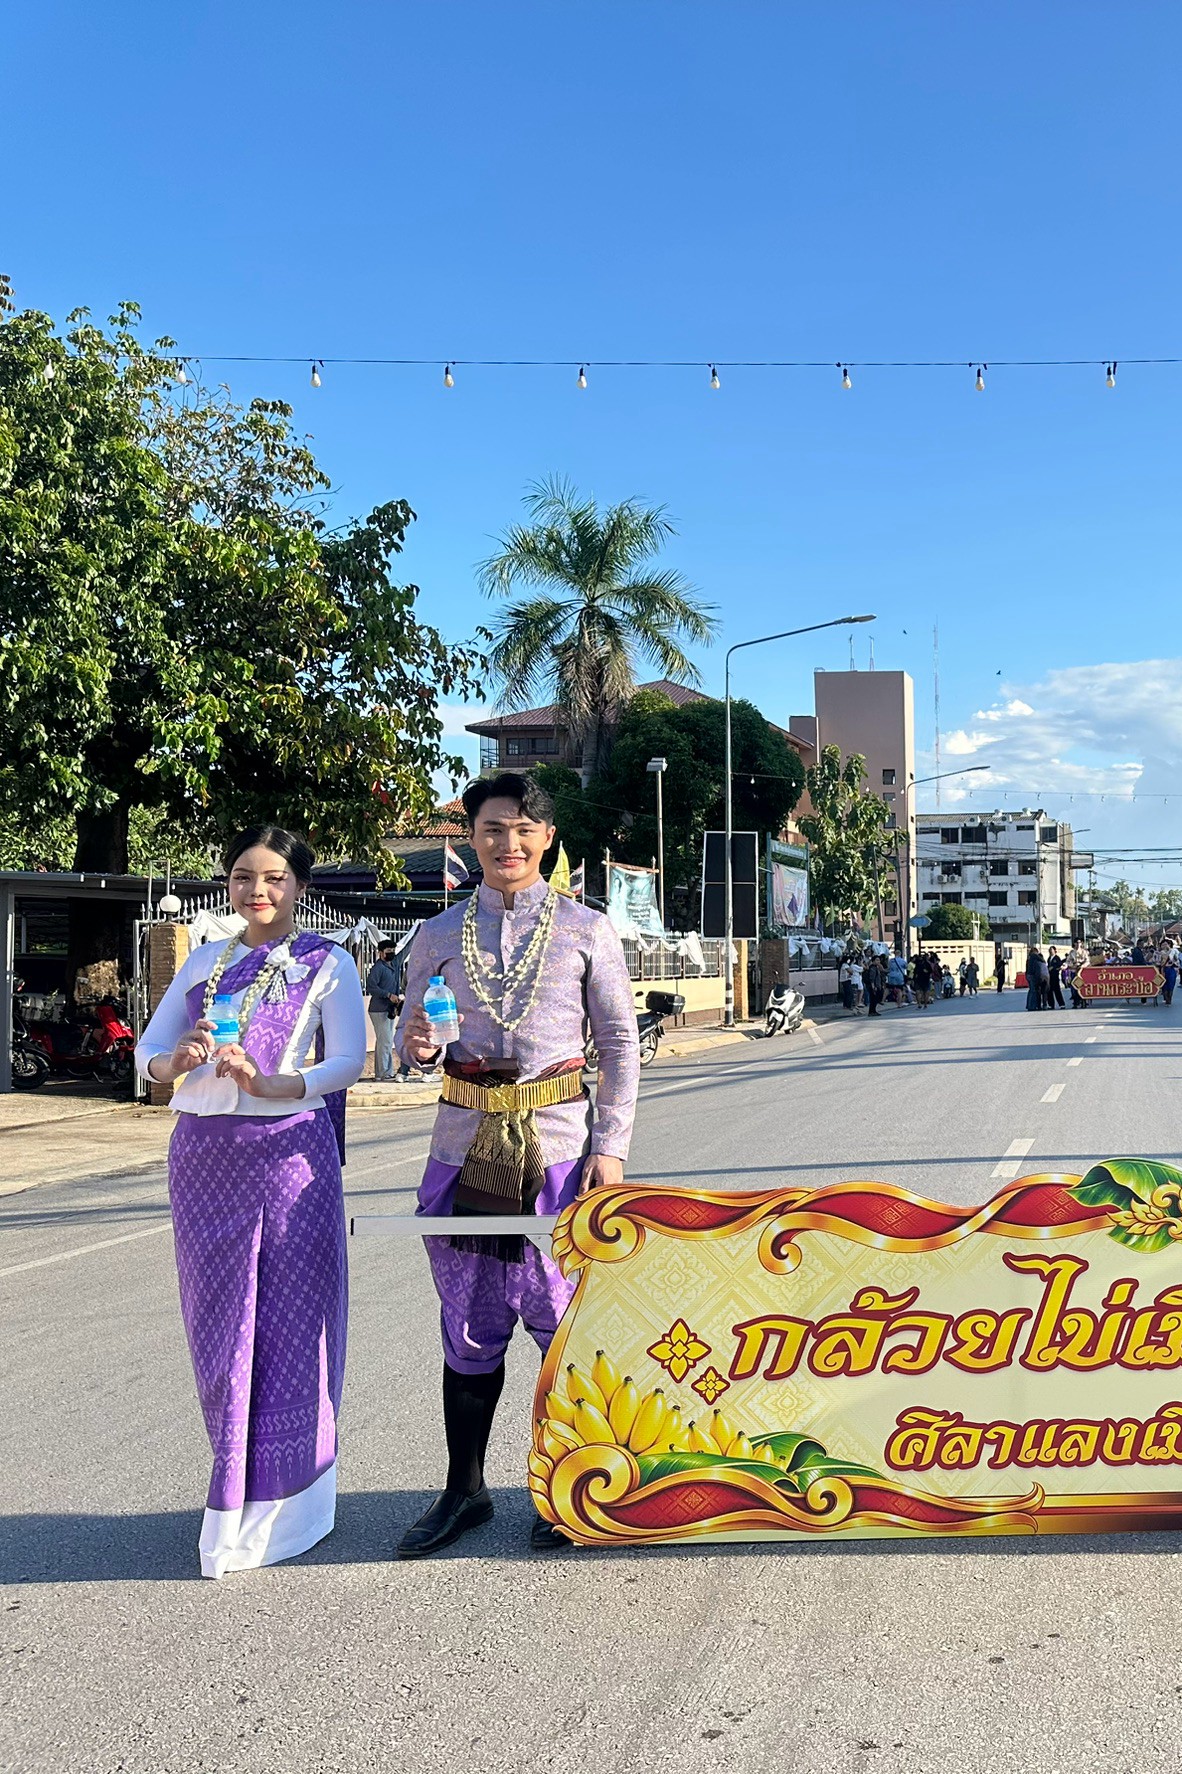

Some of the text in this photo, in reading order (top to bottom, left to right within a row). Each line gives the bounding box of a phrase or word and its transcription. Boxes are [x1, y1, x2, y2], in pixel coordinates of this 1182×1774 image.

[1097, 969, 1134, 981] อำเภอ
[1084, 976, 1154, 996] ลานกระบือ
